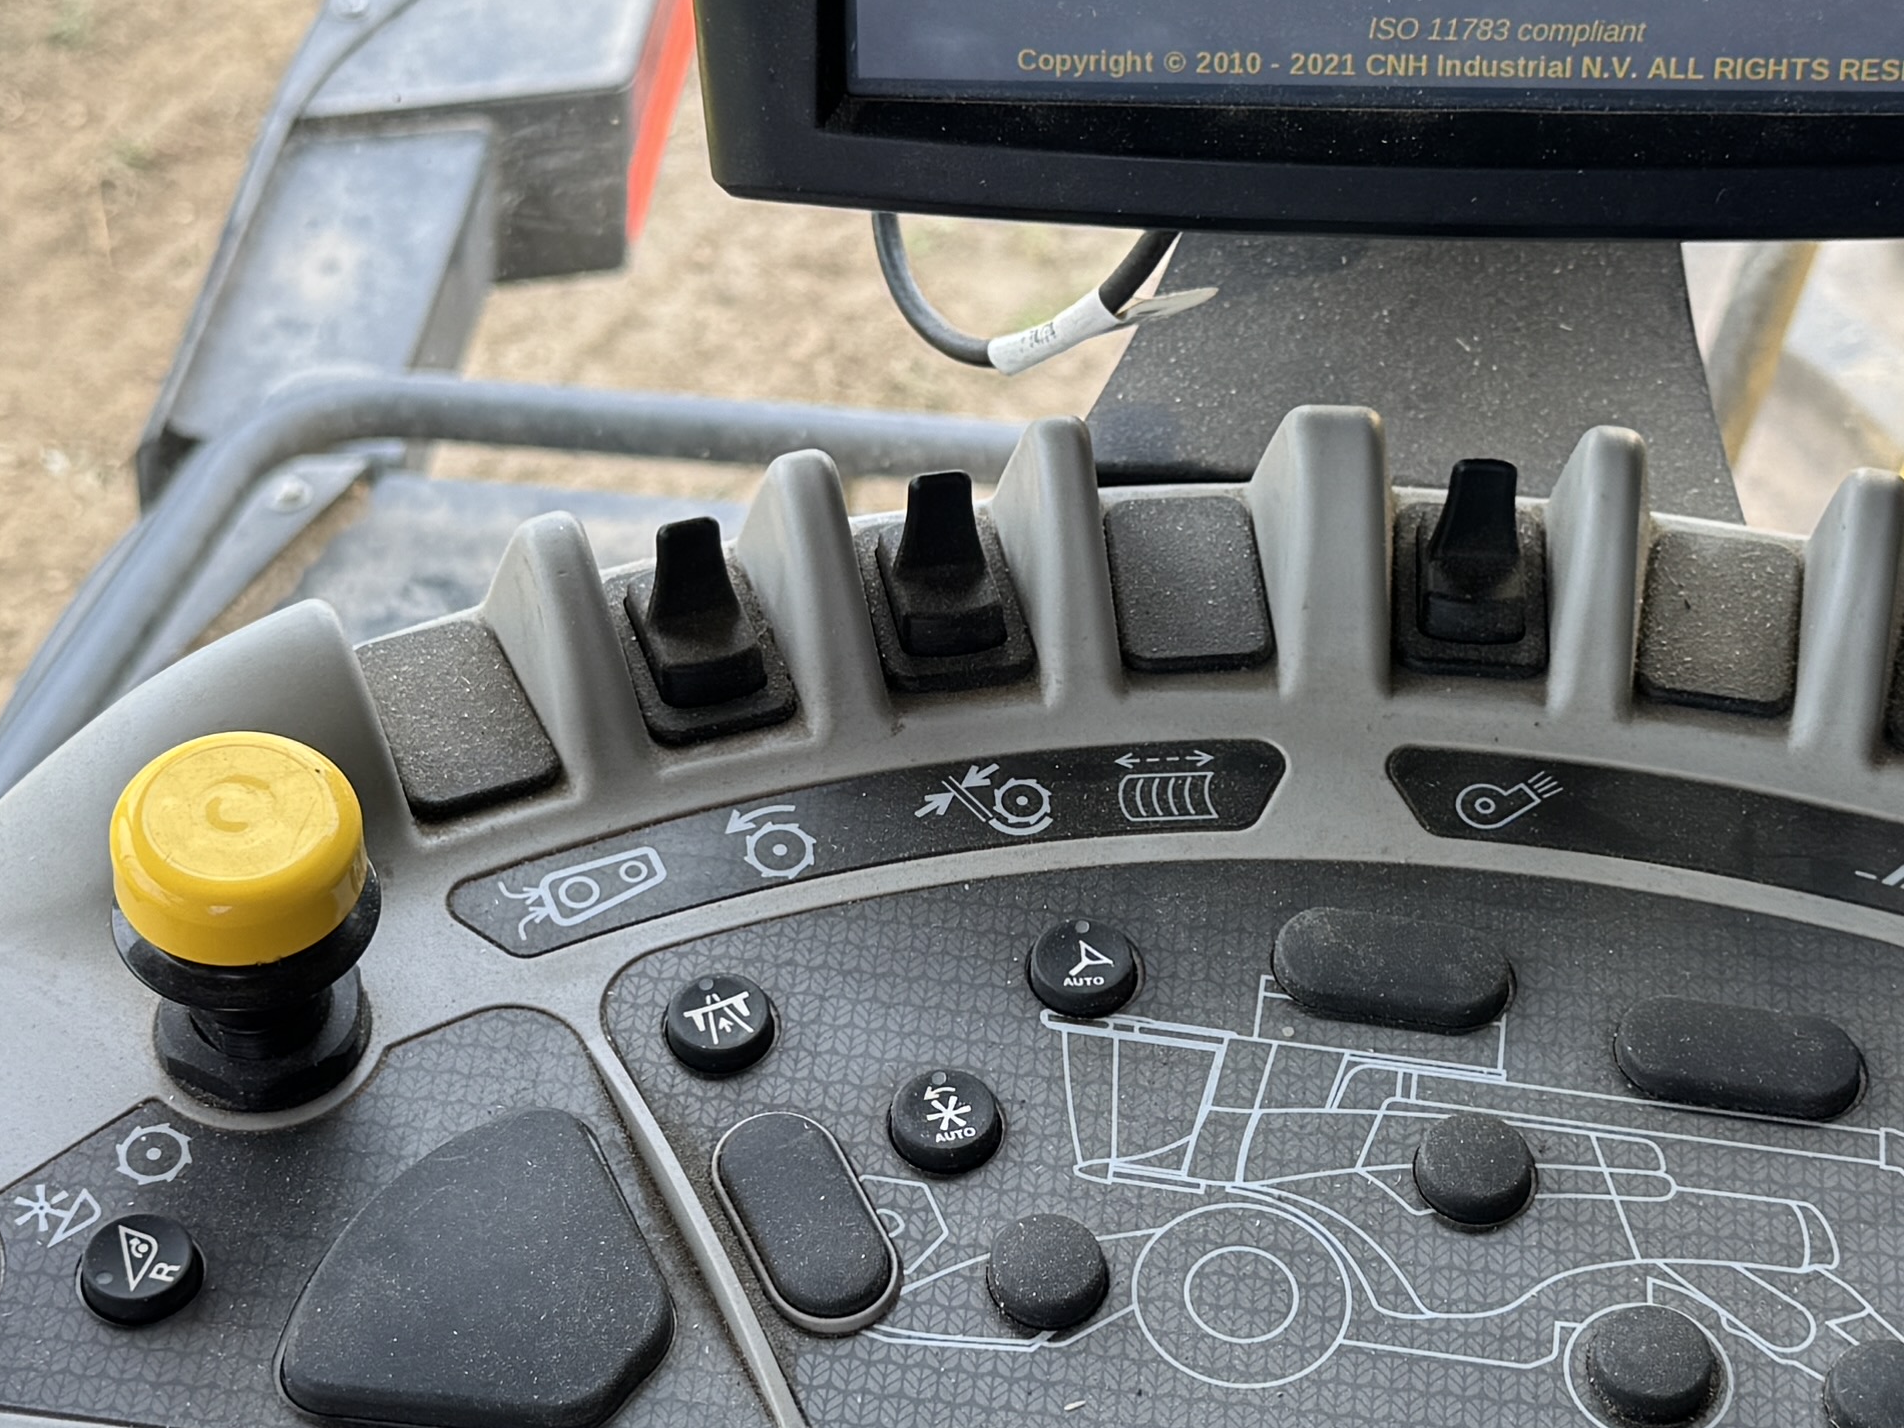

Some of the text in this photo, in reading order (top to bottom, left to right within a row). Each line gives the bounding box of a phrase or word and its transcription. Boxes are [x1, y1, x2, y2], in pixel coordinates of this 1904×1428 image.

[1368, 17, 1647, 48] ISO 11783 compliant
[1017, 48, 1154, 78] Copyright
[1196, 52, 1262, 75] 2010
[1290, 53, 1356, 76] 2021
[1366, 53, 1428, 77] CNH
[1437, 54, 1572, 79] Industrial
[1580, 56, 1637, 79] N.V.
[1647, 56, 1703, 80] ALL
[1713, 58, 1831, 81] RIGHTS
[1063, 976, 1105, 986] AUTO
[935, 1127, 977, 1143] AUTO
[148, 1262, 181, 1283] R
